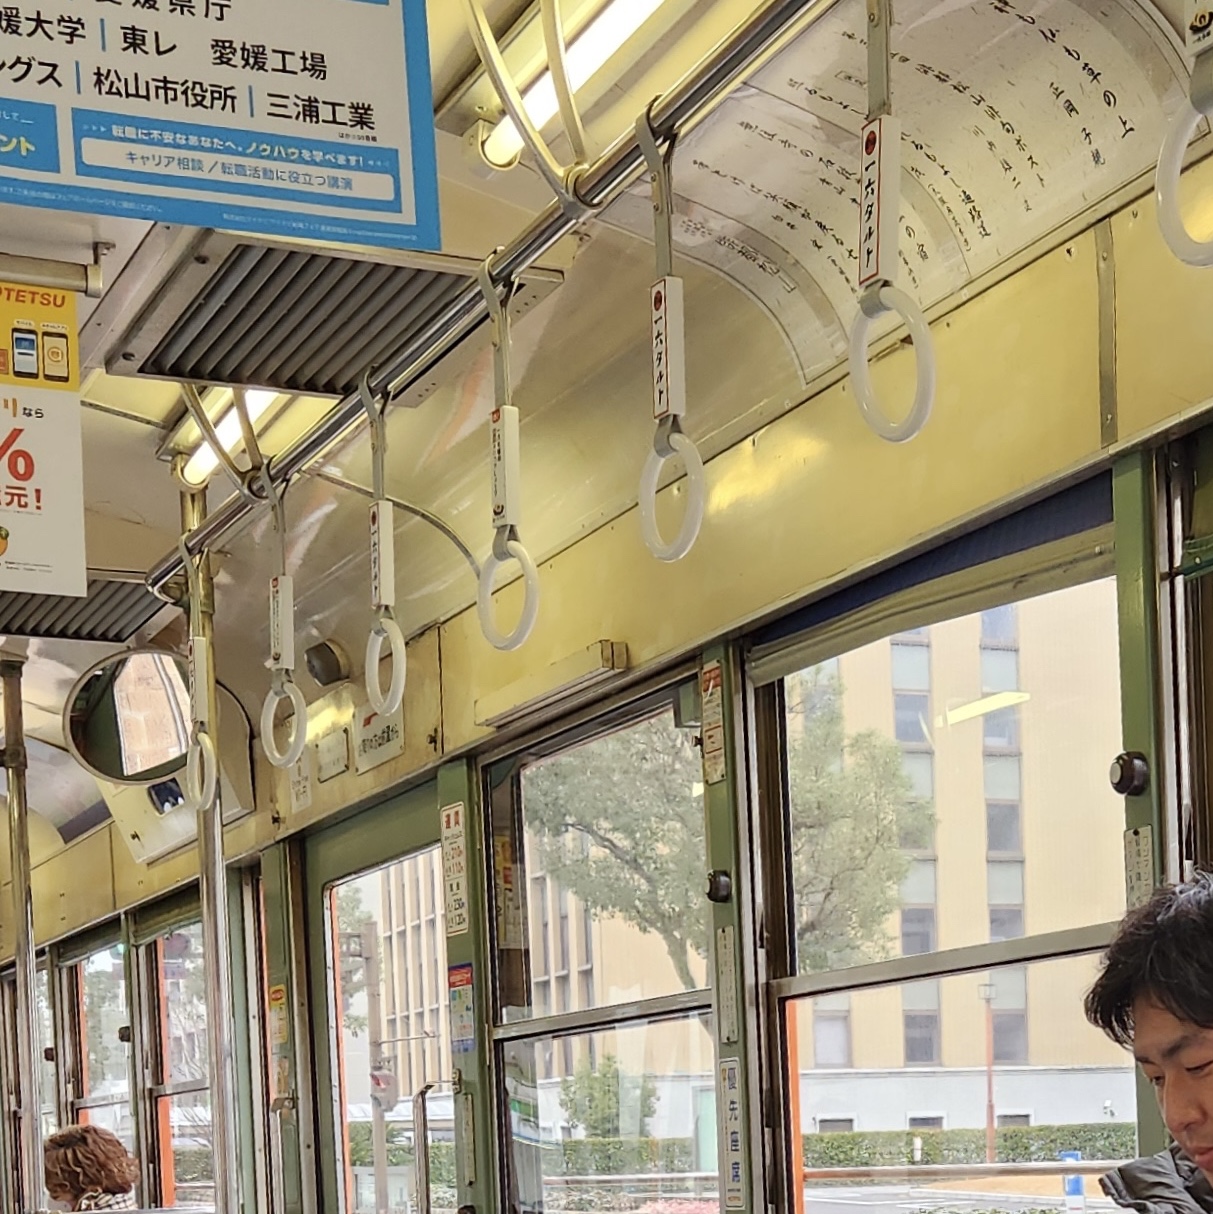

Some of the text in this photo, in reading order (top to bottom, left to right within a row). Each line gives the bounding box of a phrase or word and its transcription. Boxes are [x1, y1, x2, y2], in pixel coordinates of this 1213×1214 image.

[120, 25, 177, 56] 東レ
[210, 39, 328, 81] 愛媛工場
[0, 56, 375, 131] グス 松山市役所 三浦工業
[0, 287, 66, 308] TETSU
[0, 485, 42, 510] 元!
